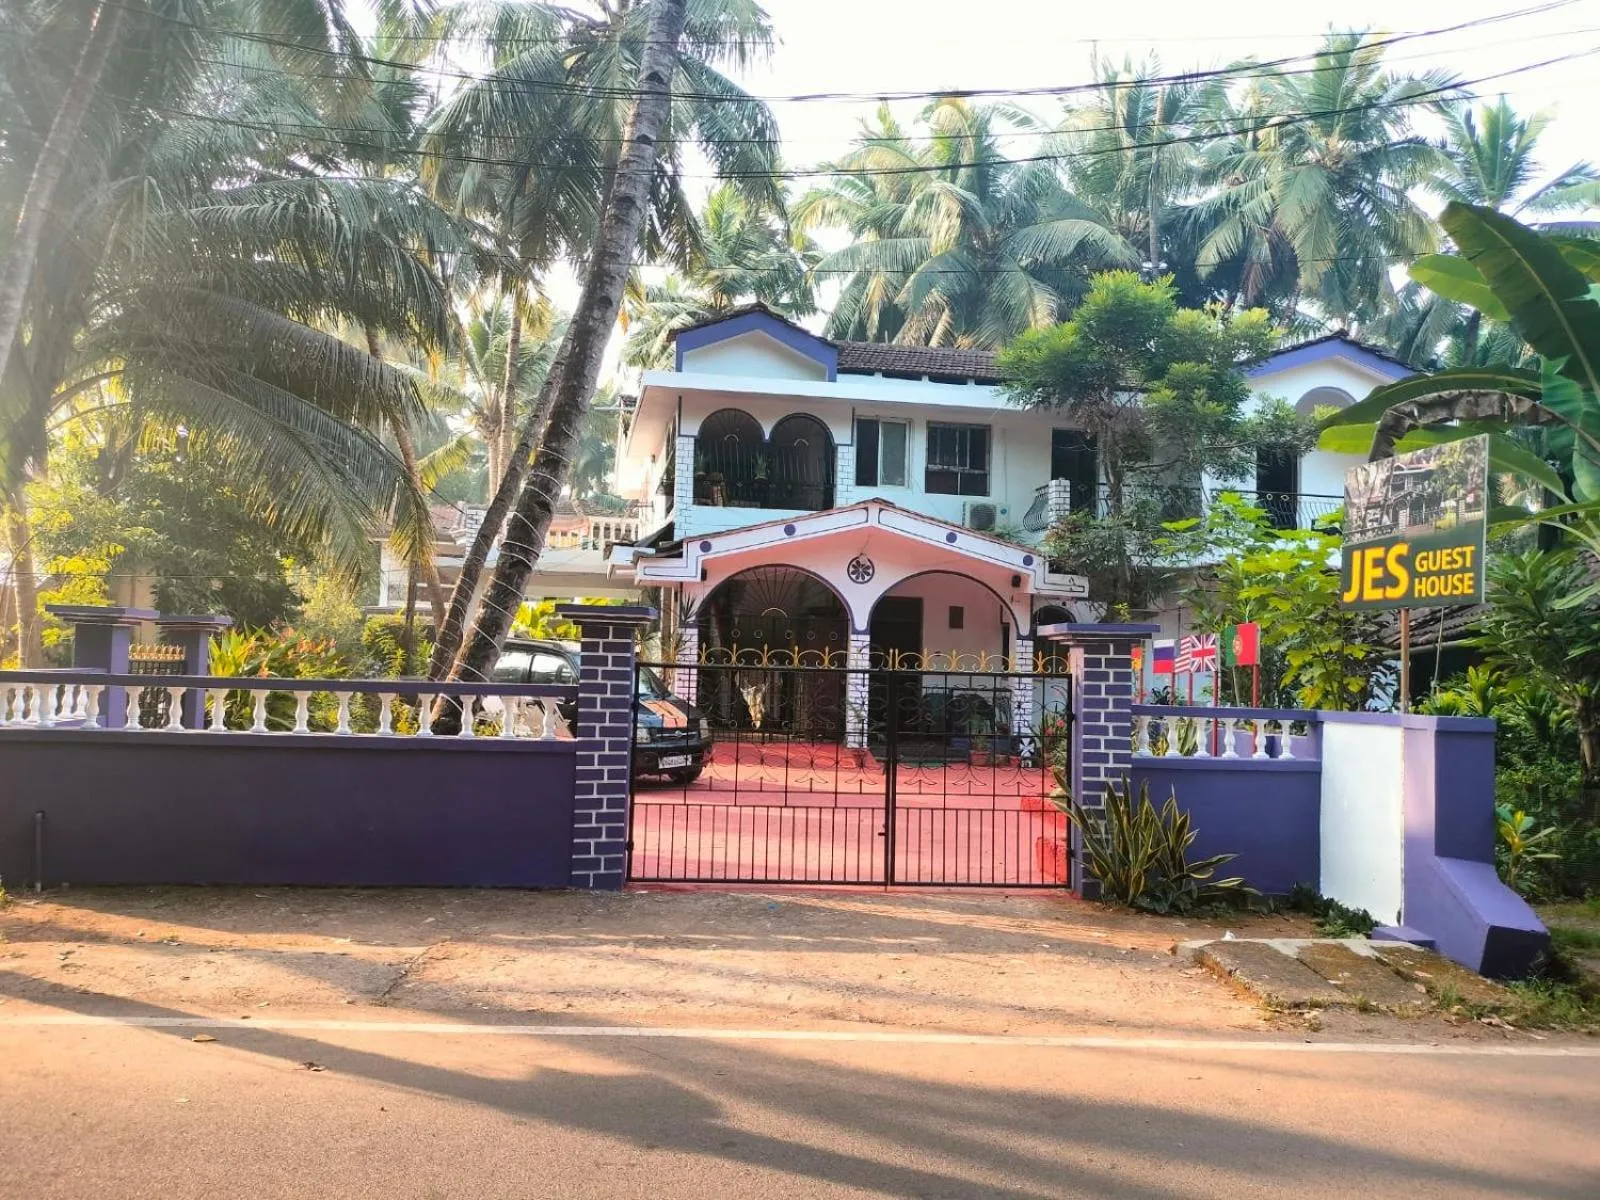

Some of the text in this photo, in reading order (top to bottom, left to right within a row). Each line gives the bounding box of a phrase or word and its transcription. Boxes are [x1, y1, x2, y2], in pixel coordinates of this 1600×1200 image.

[1343, 541, 1410, 603] JES
[1414, 545, 1475, 573] GUEST
[1414, 572, 1475, 598] HOUSE
